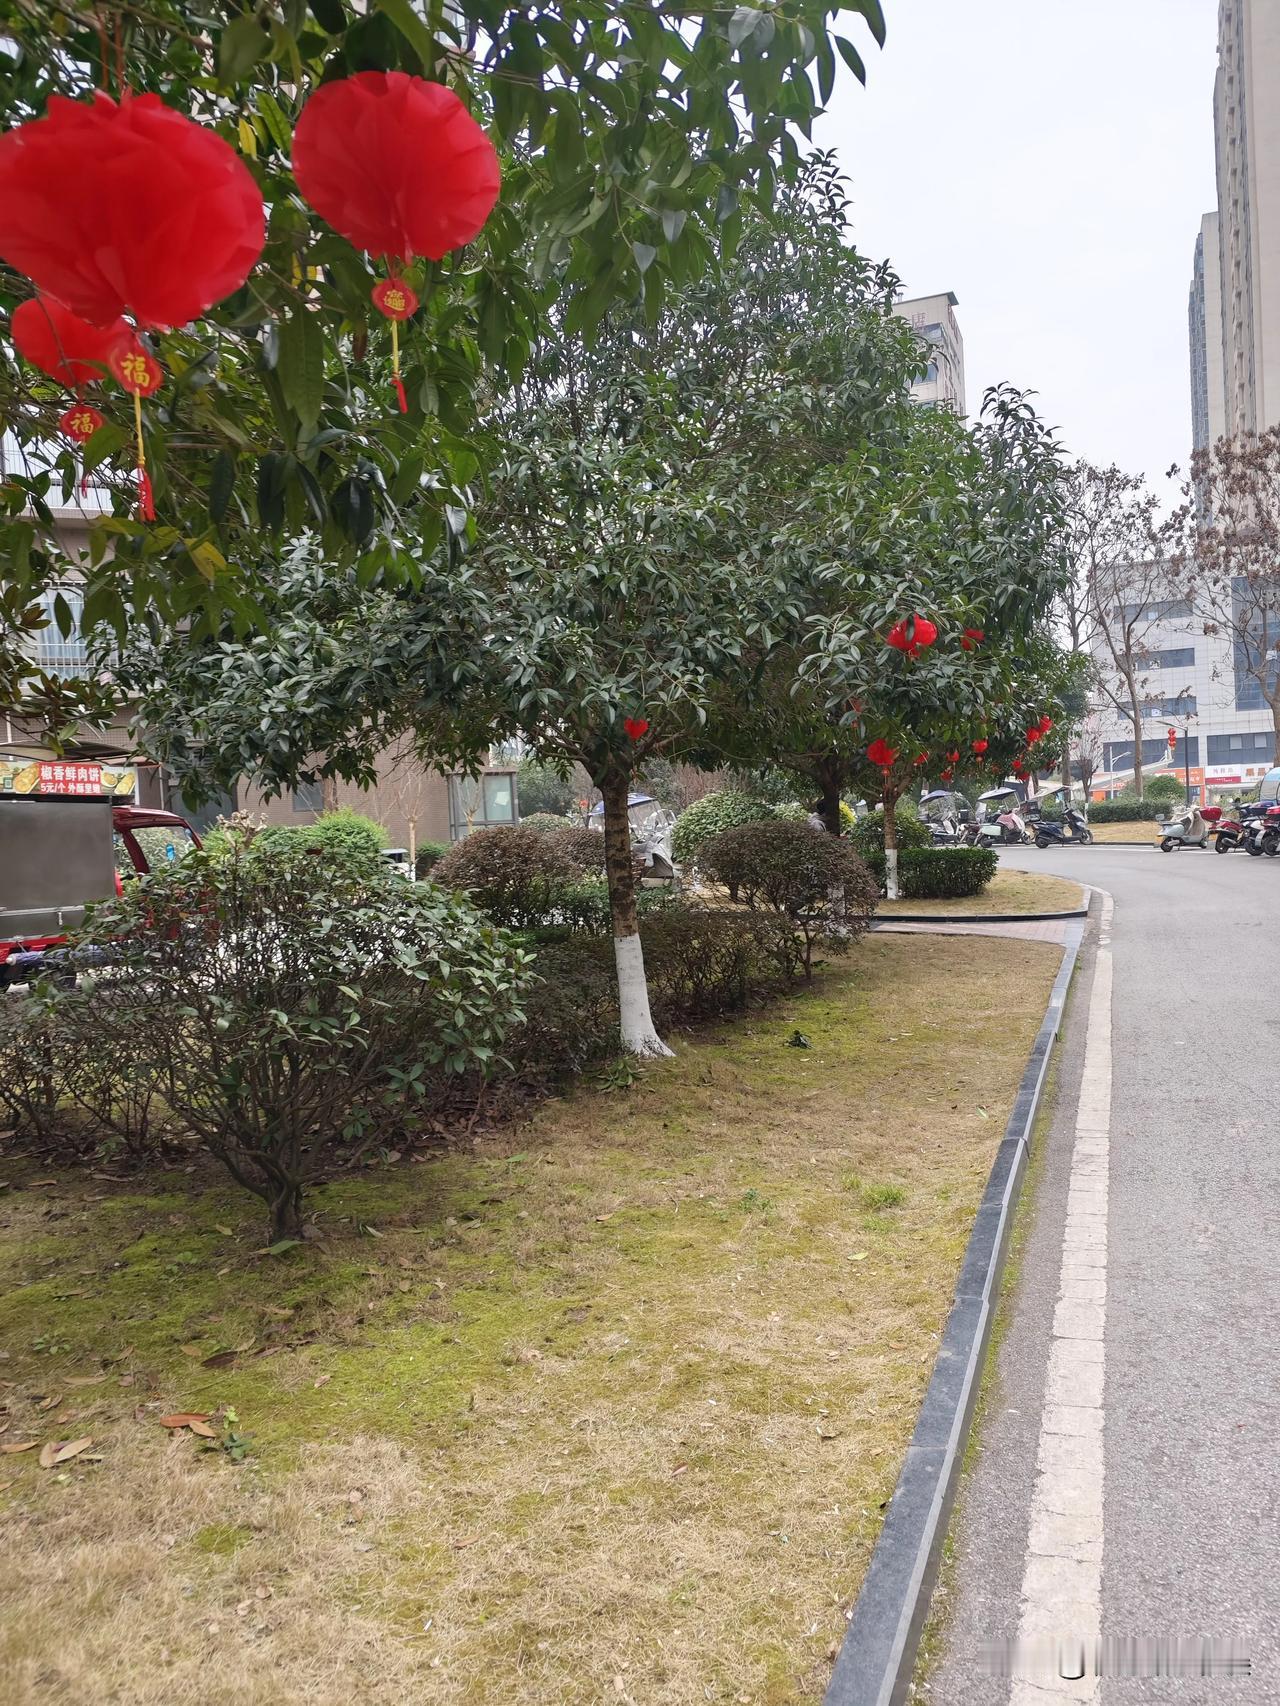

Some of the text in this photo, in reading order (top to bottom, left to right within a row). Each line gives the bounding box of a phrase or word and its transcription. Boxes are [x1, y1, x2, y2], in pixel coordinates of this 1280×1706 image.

[120, 352, 150, 388] 福
[70, 412, 94, 434] 福
[41, 765, 100, 782] 椒香鲜肉饼
